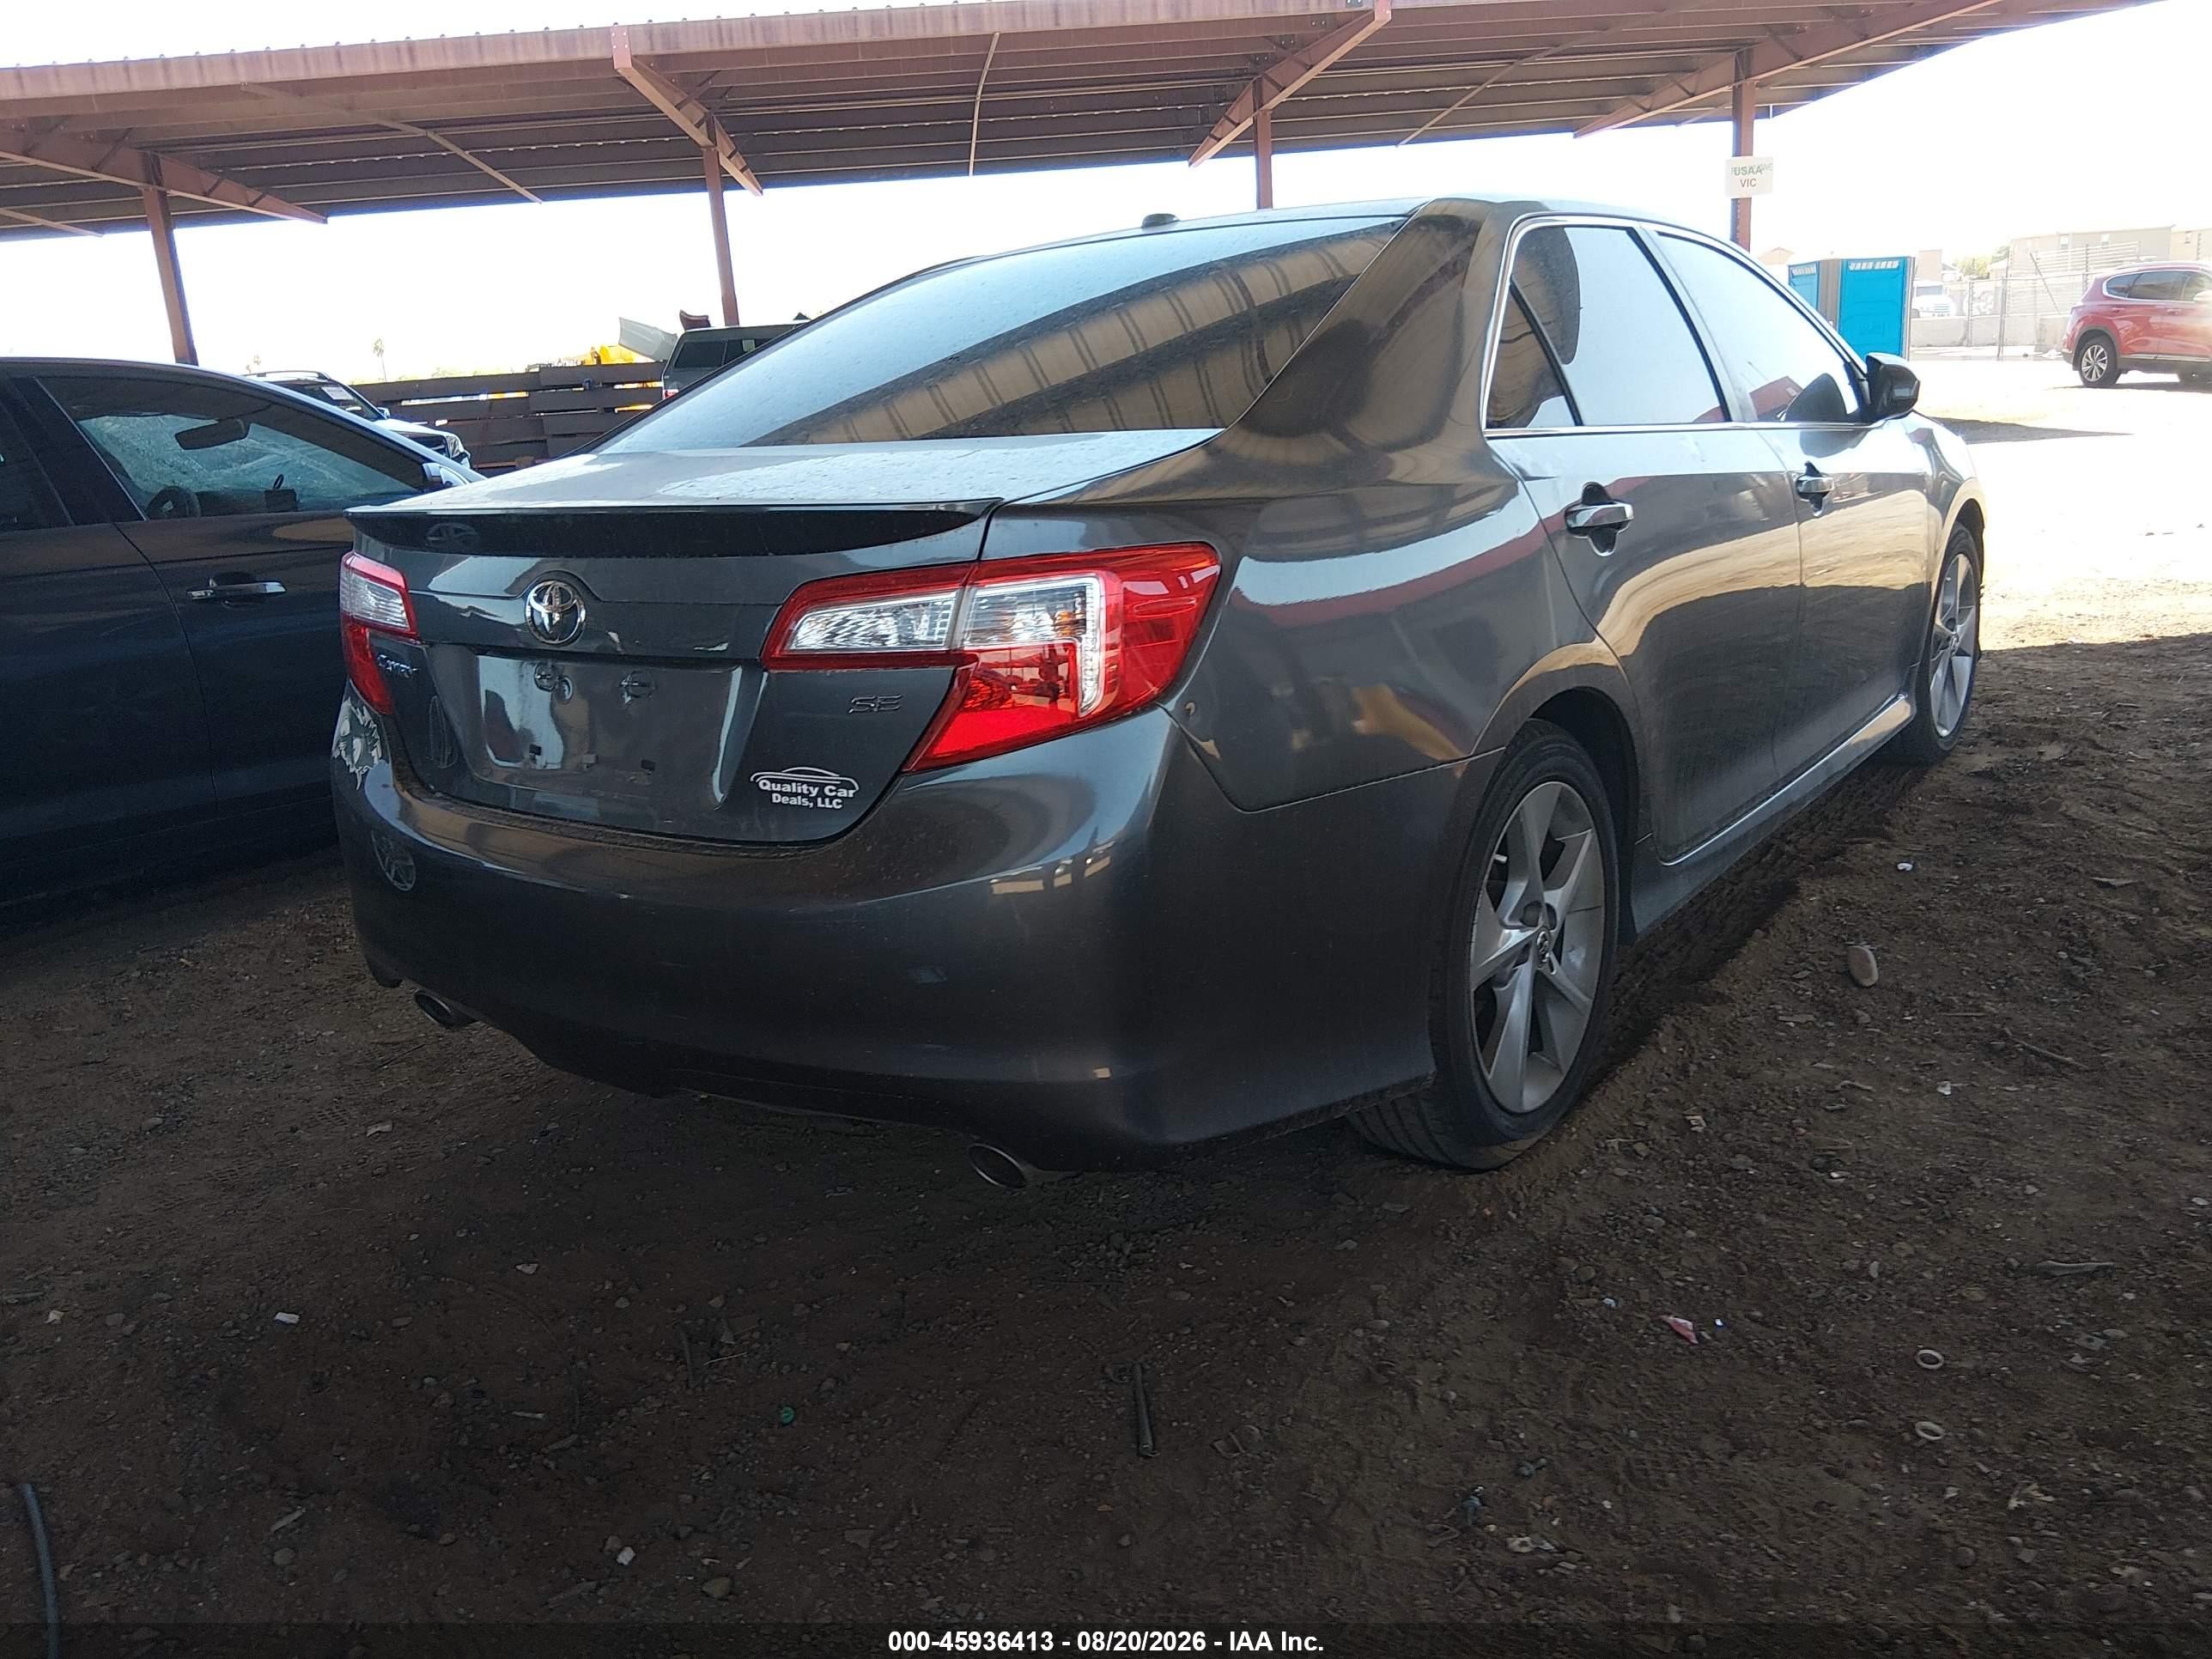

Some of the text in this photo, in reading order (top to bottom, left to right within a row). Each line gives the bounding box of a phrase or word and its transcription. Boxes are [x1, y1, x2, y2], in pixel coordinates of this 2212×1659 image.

[1734, 166, 1763, 176] USAA
[1740, 178, 1757, 188] VIC
[848, 694, 902, 714] SE
[758, 779, 856, 799] Quality Car
[771, 793, 843, 810] Deals, LLC
